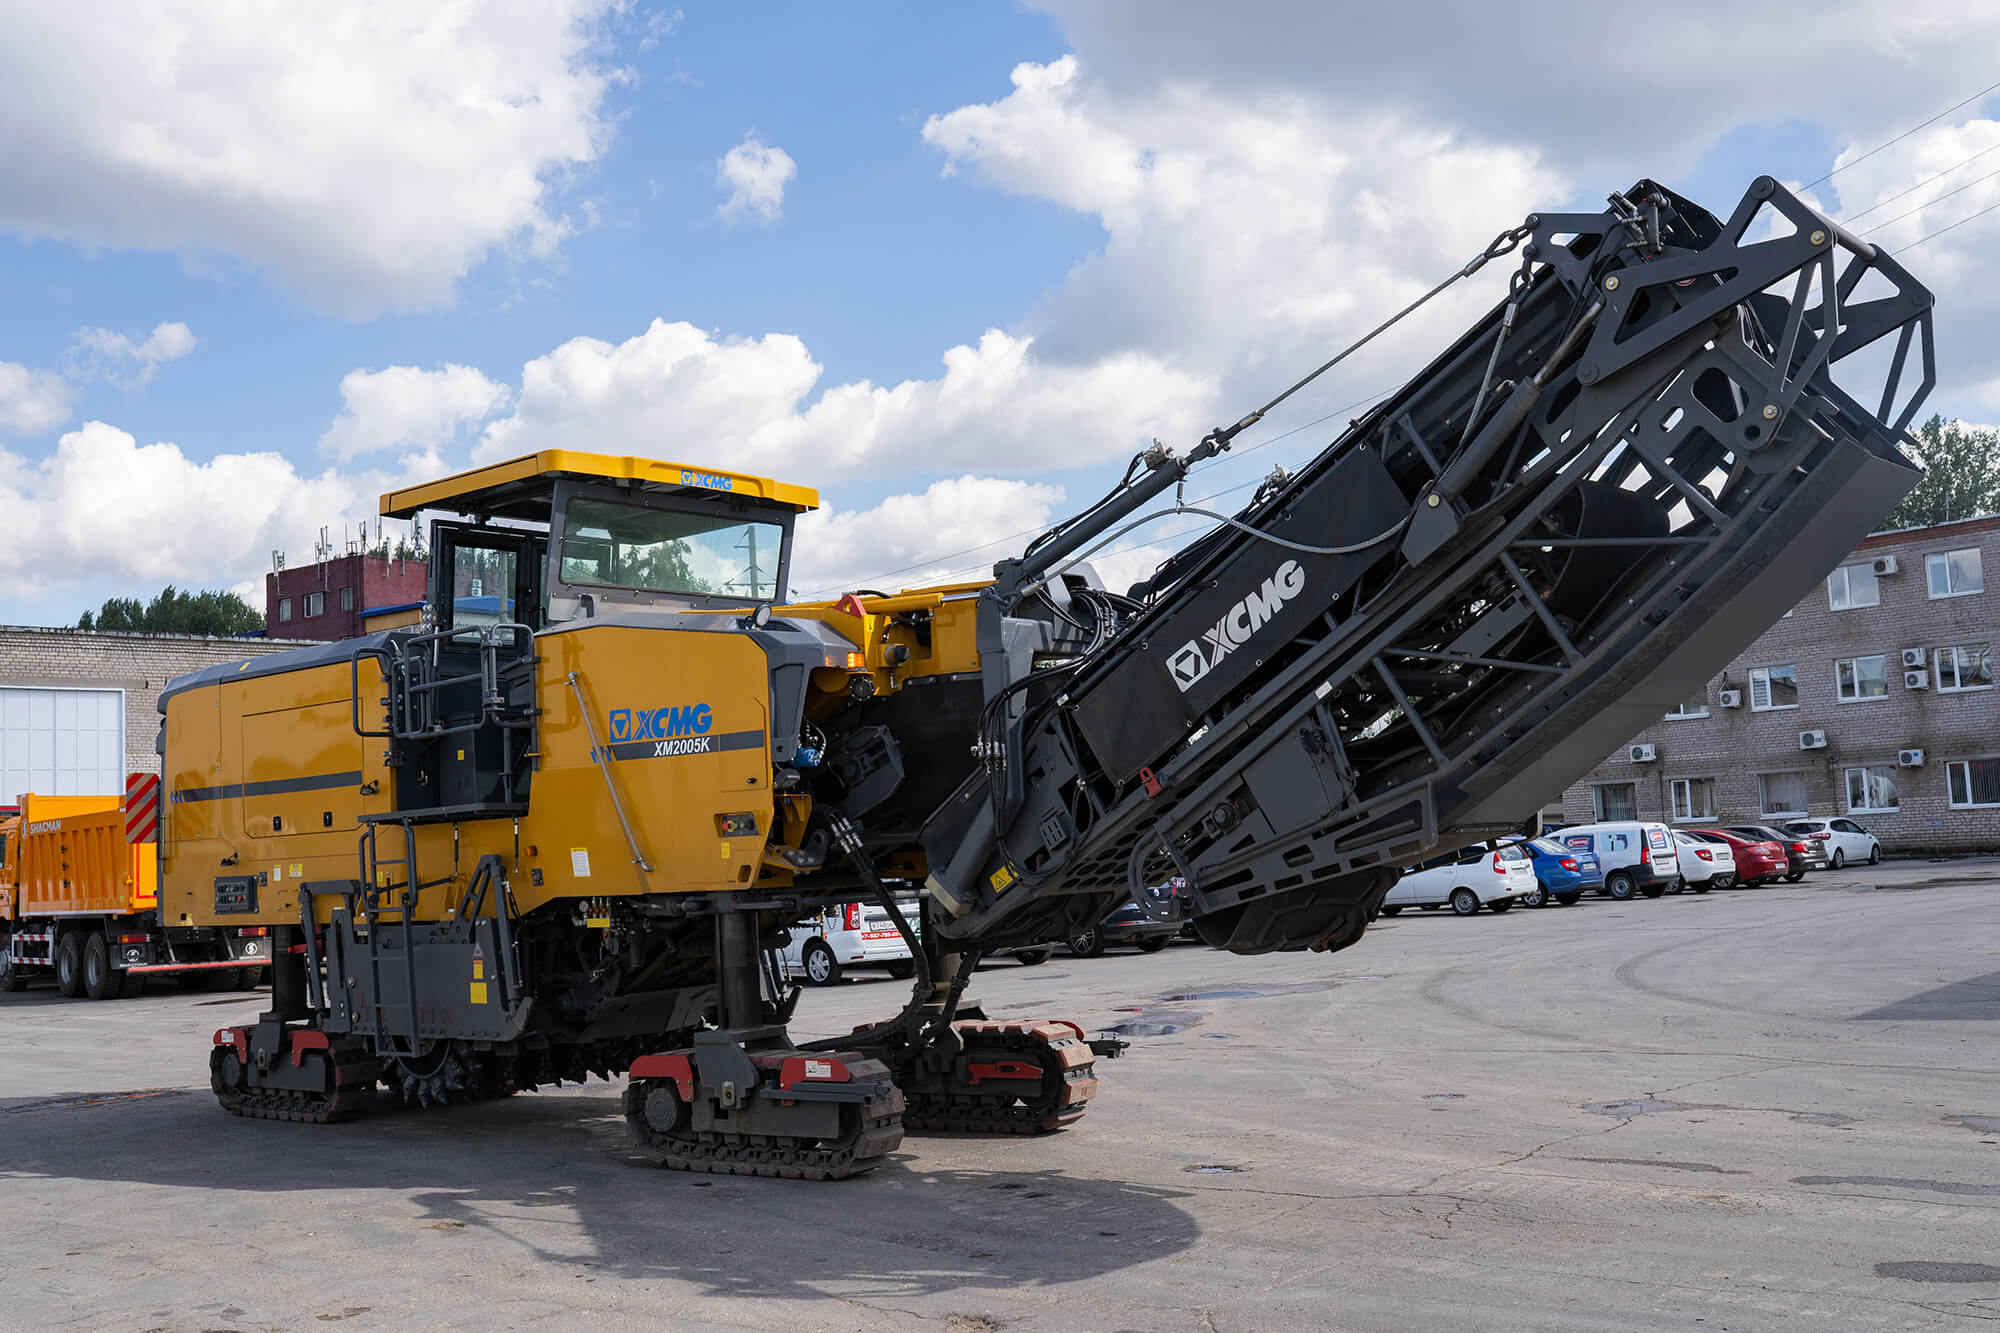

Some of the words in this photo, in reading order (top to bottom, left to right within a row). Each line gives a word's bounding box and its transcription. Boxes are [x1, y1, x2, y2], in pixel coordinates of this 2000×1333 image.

[694, 473, 732, 490] XCMG
[1201, 560, 1305, 669] XCMG
[631, 703, 713, 740] XCMG
[654, 737, 711, 757] XM2005K
[30, 820, 61, 834] SHACMAN
